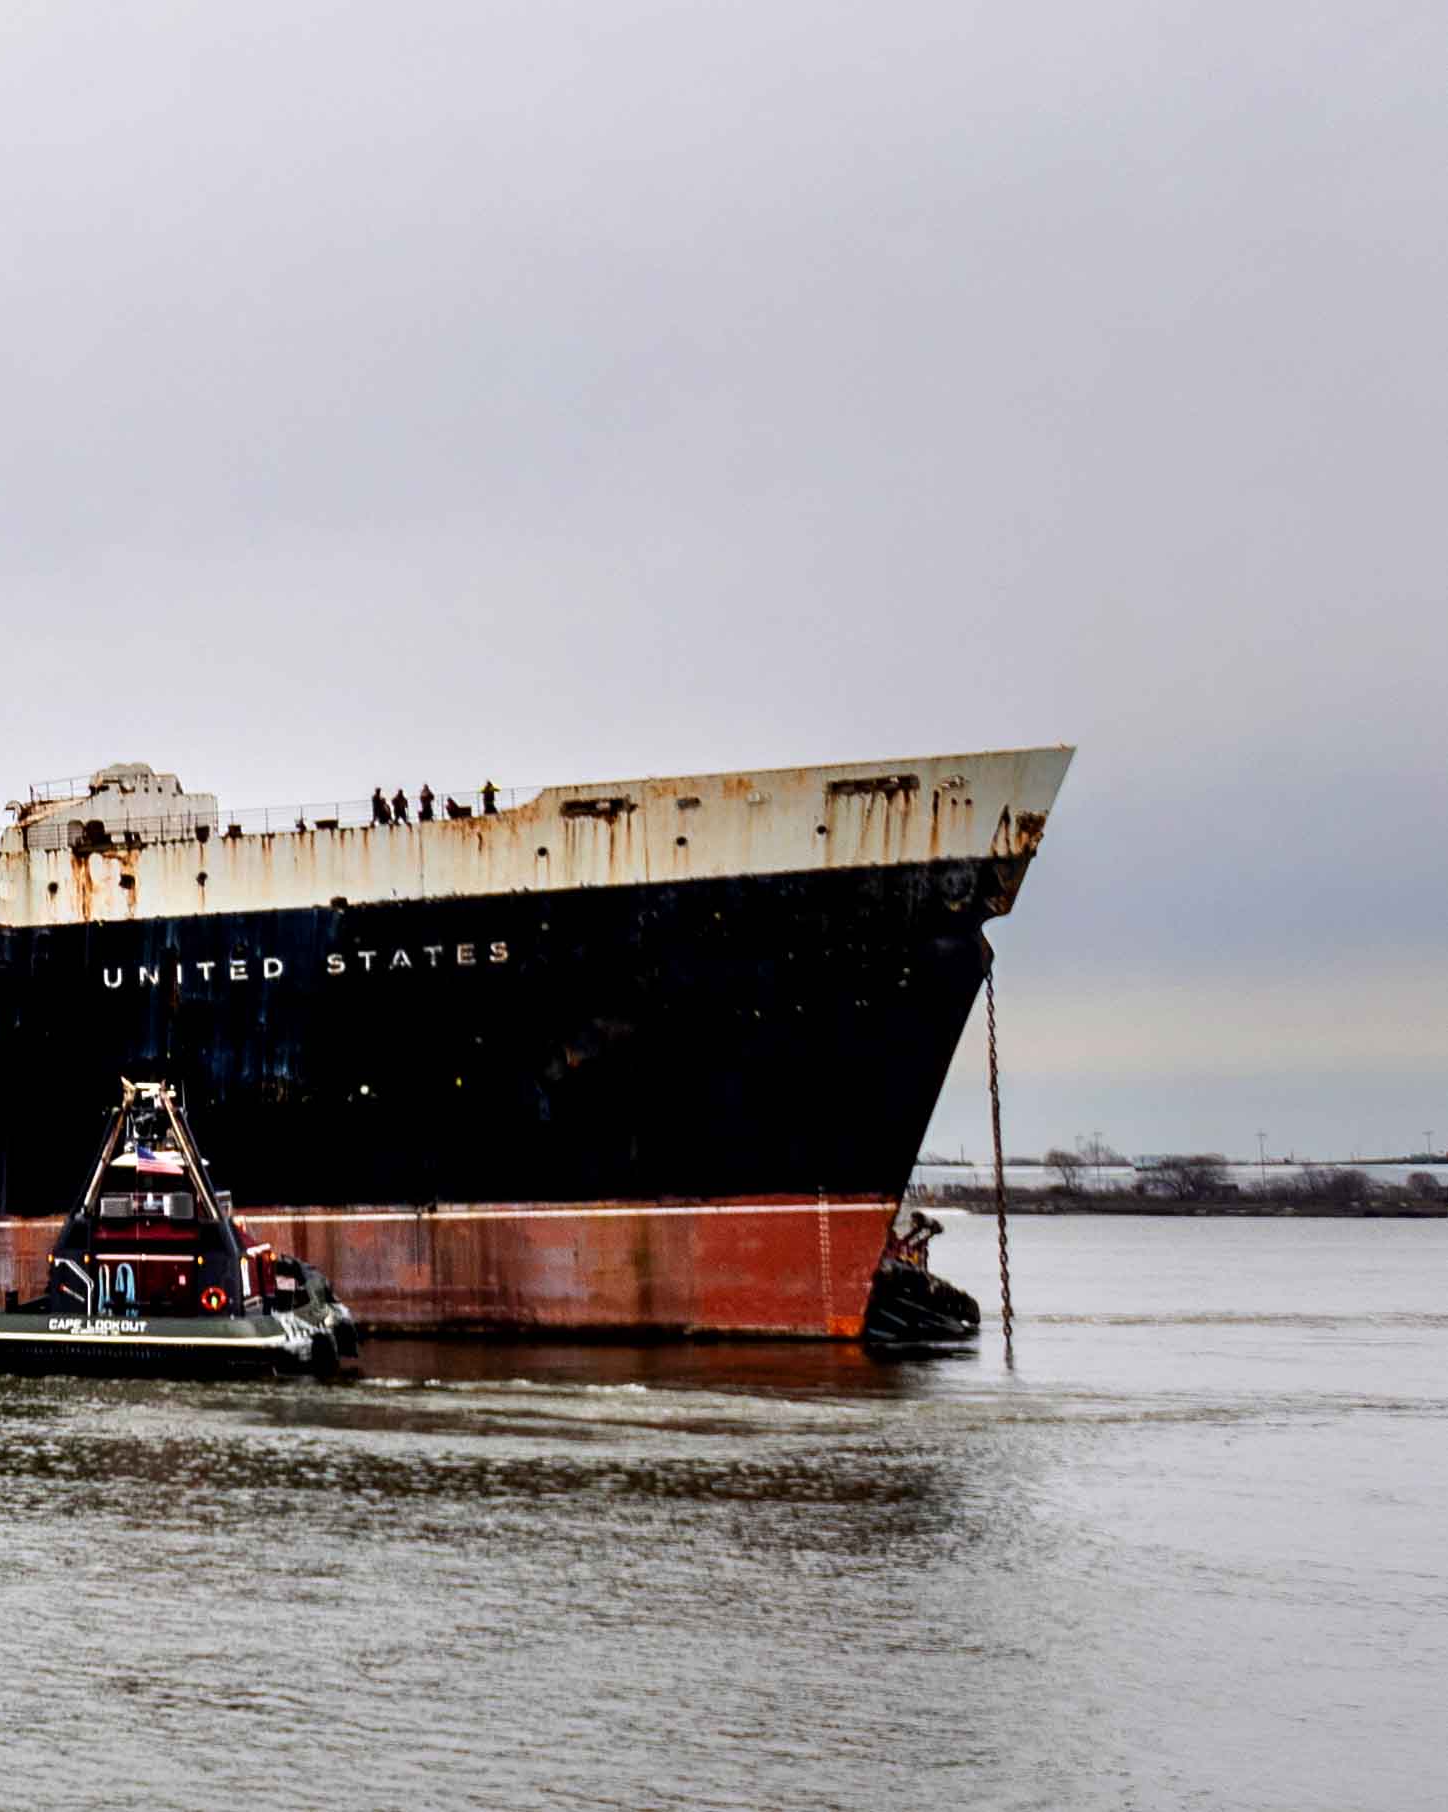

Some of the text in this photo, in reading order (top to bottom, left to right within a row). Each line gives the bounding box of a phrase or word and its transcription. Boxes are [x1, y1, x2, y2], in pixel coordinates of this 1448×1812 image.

[103, 941, 508, 988] UNITED STATES
[48, 1317, 82, 1330] CAPE
[86, 1319, 147, 1332] LOOKOUT
